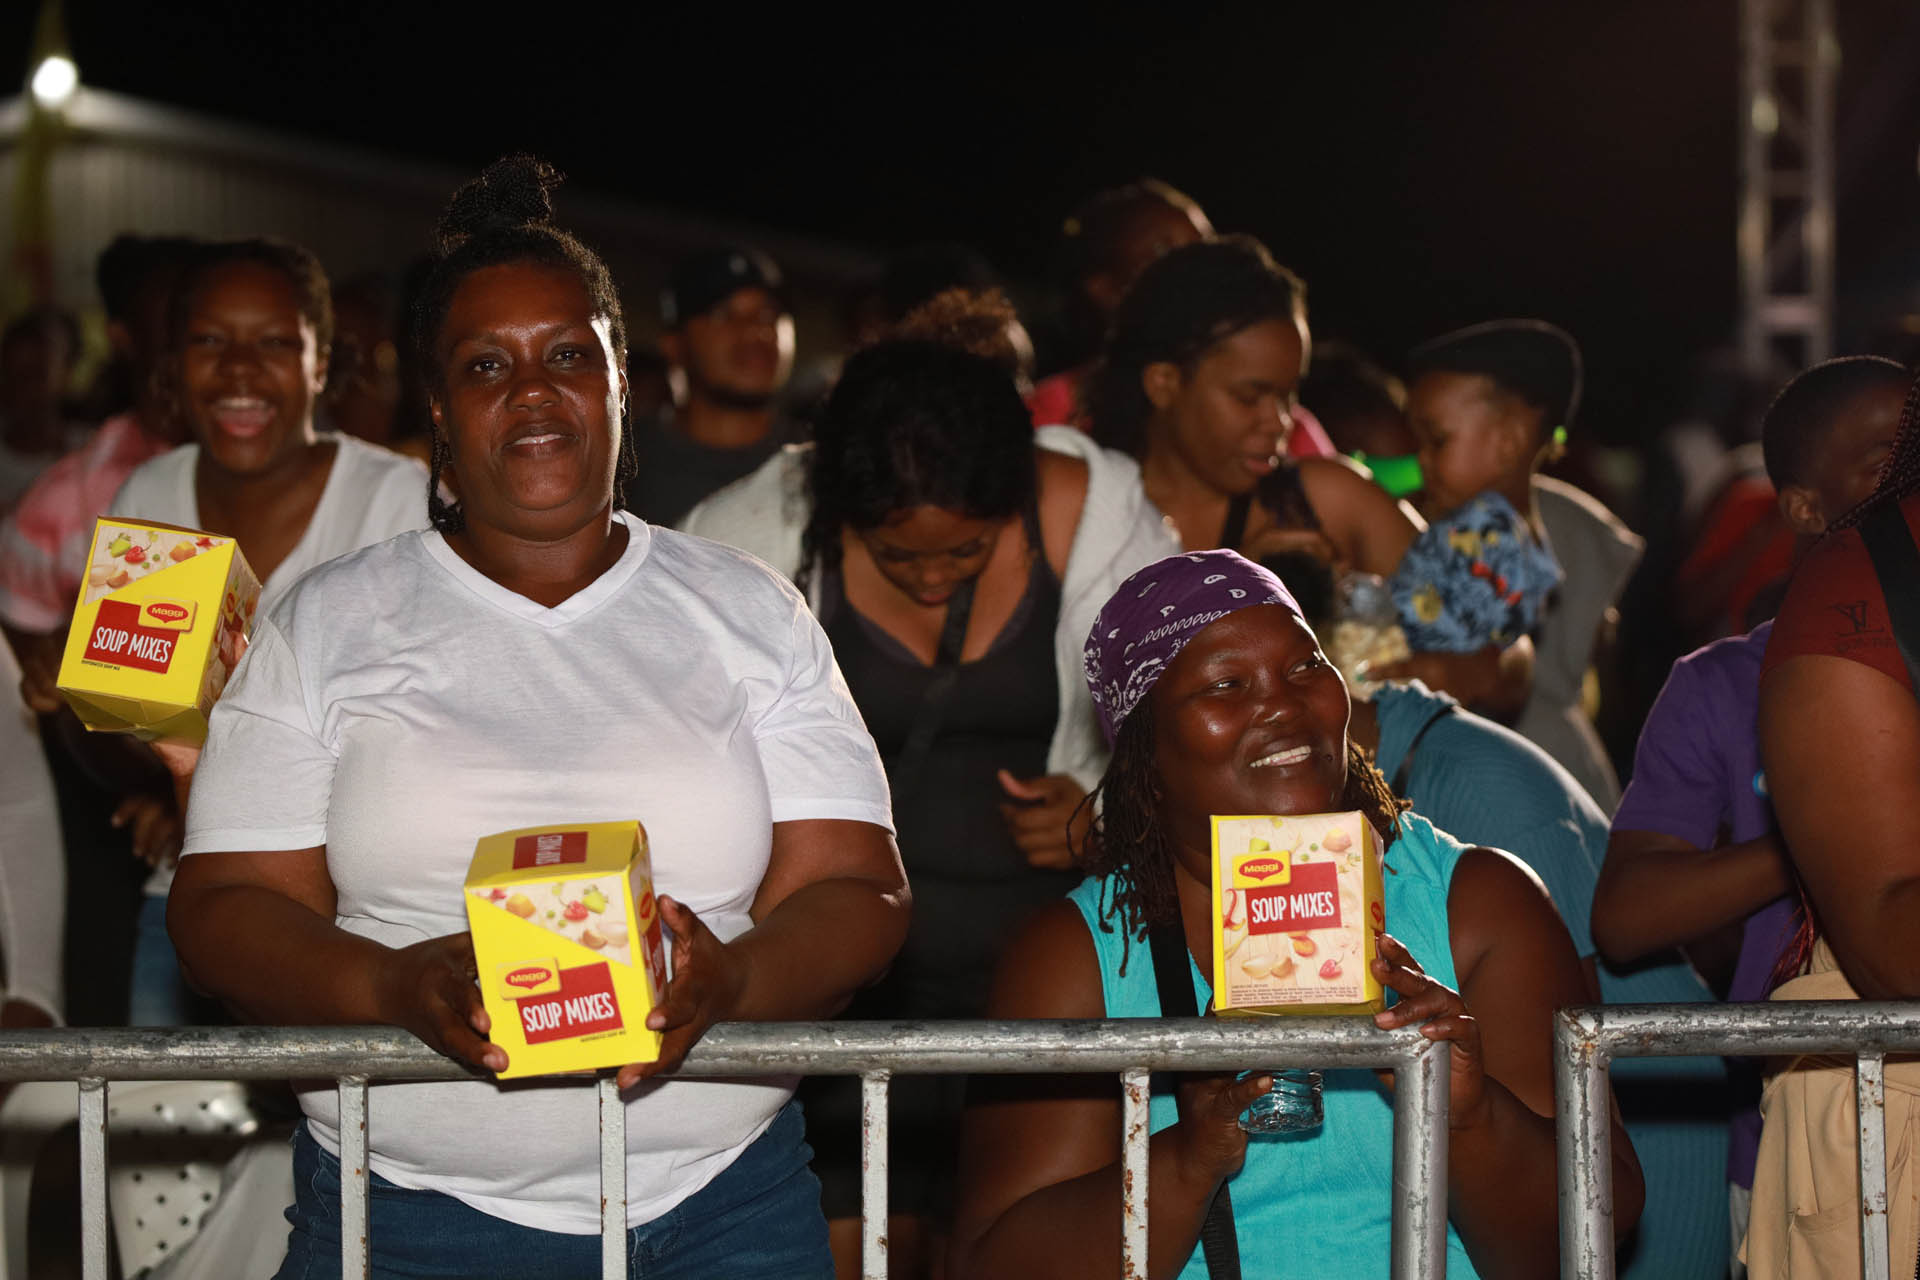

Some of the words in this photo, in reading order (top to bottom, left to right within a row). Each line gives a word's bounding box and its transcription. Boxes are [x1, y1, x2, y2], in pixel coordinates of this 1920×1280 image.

[151, 606, 184, 618] Maggi
[92, 626, 129, 654] SOUP
[127, 633, 171, 663] MIXES
[1244, 862, 1279, 873] Maggi
[1251, 896, 1287, 924] SOUP
[1290, 891, 1335, 920] MIXES
[522, 1002, 562, 1033] SOUP
[564, 992, 615, 1026] MIXES
